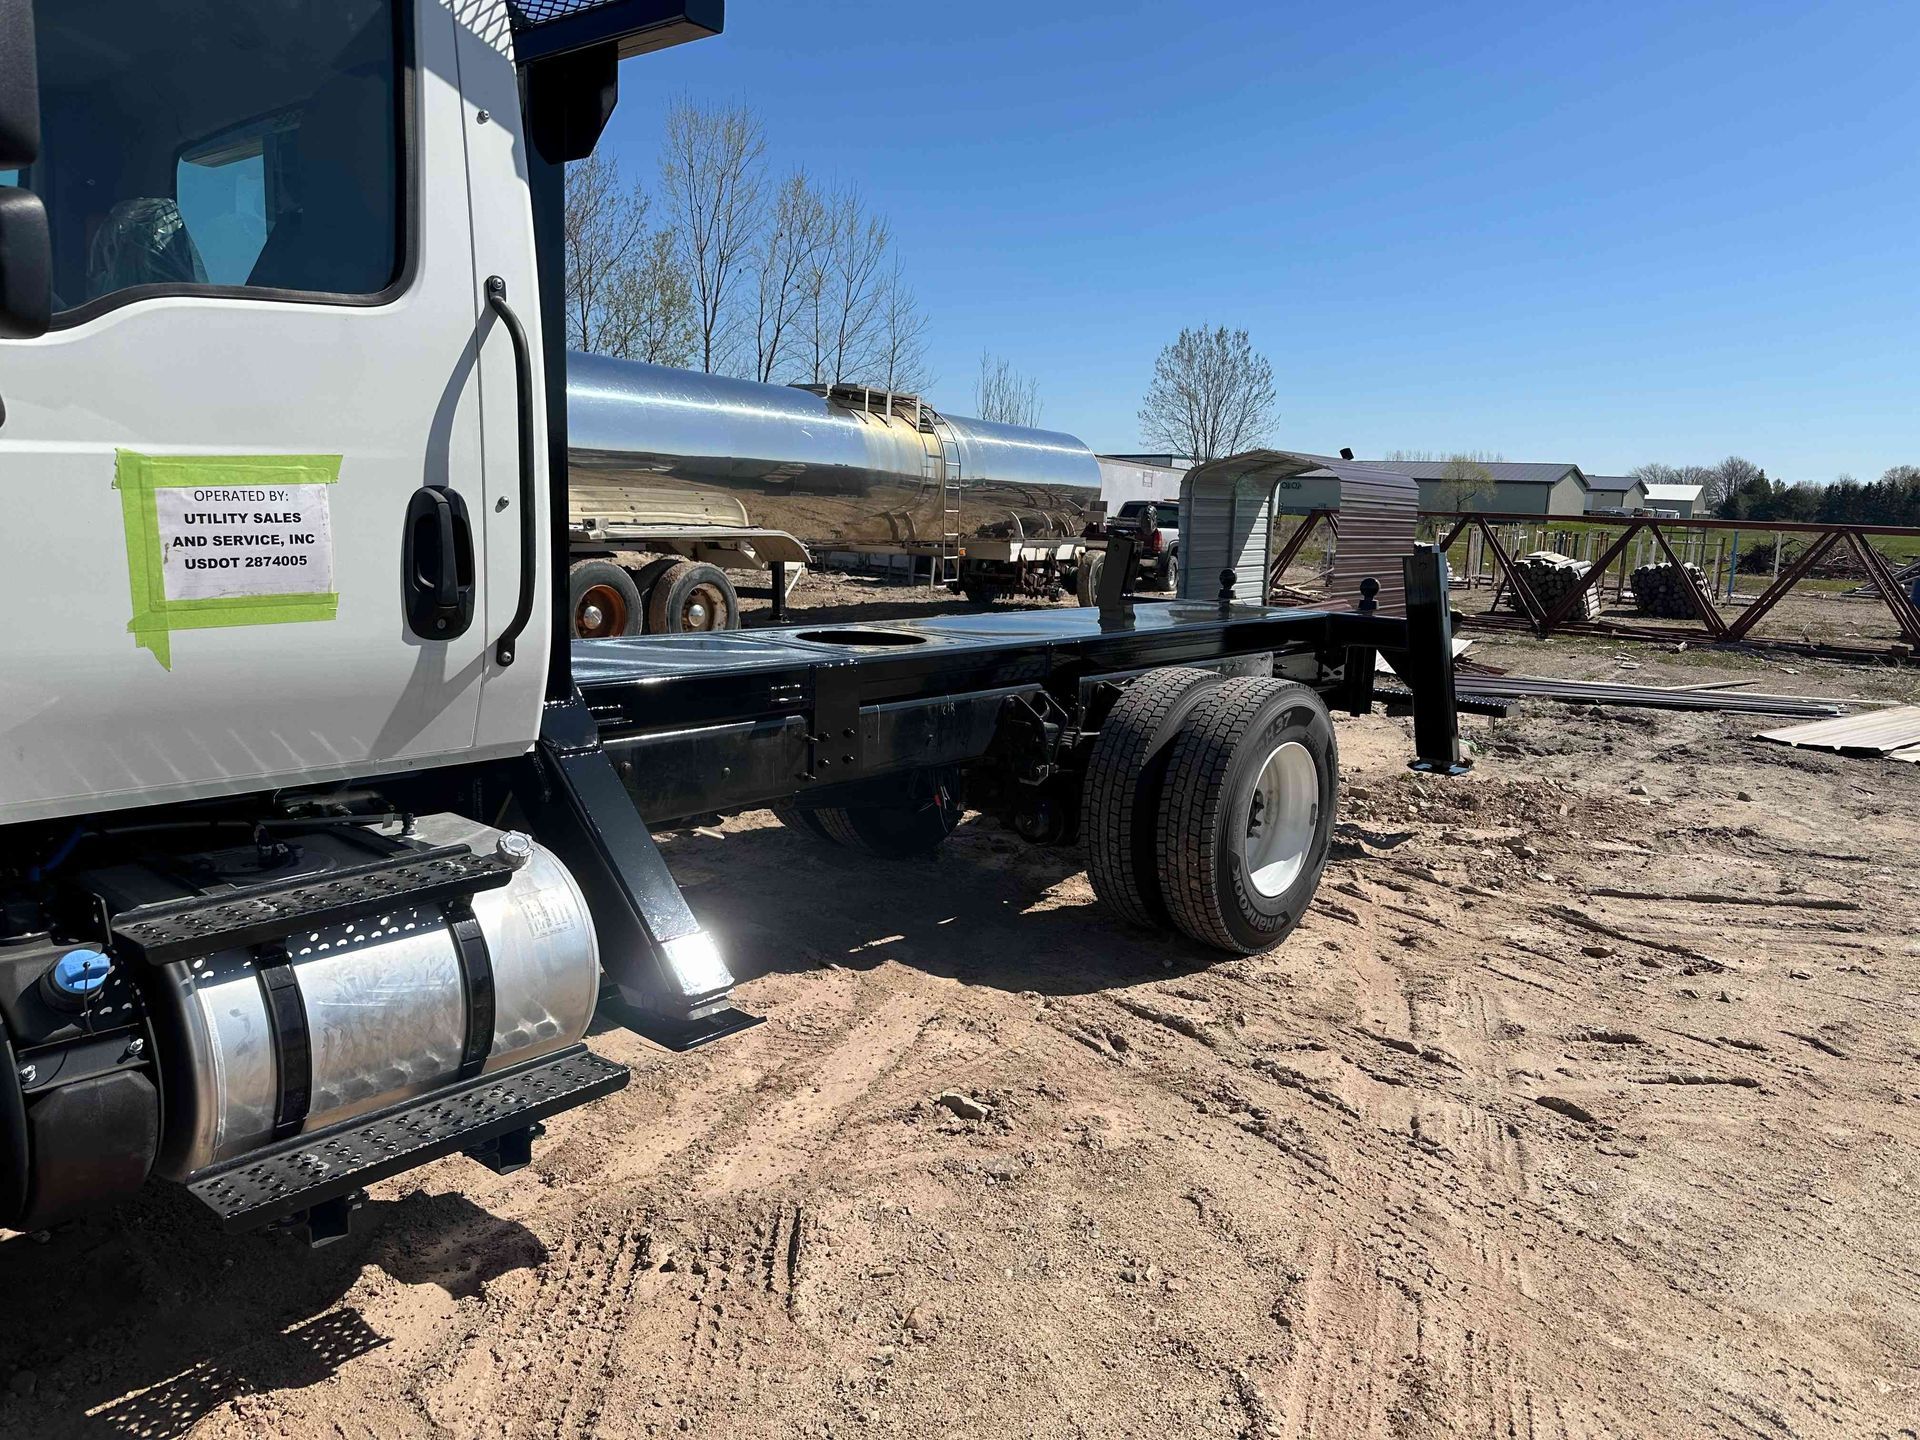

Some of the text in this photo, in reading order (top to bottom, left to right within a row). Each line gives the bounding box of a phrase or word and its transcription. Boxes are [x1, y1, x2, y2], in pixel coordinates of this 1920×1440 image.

[194, 490, 290, 502] OPERATED BY:
[184, 512, 302, 525] UTILITY SALES
[172, 533, 316, 548] AND SERVICE, INC
[184, 555, 308, 570] USDOT 2874005
